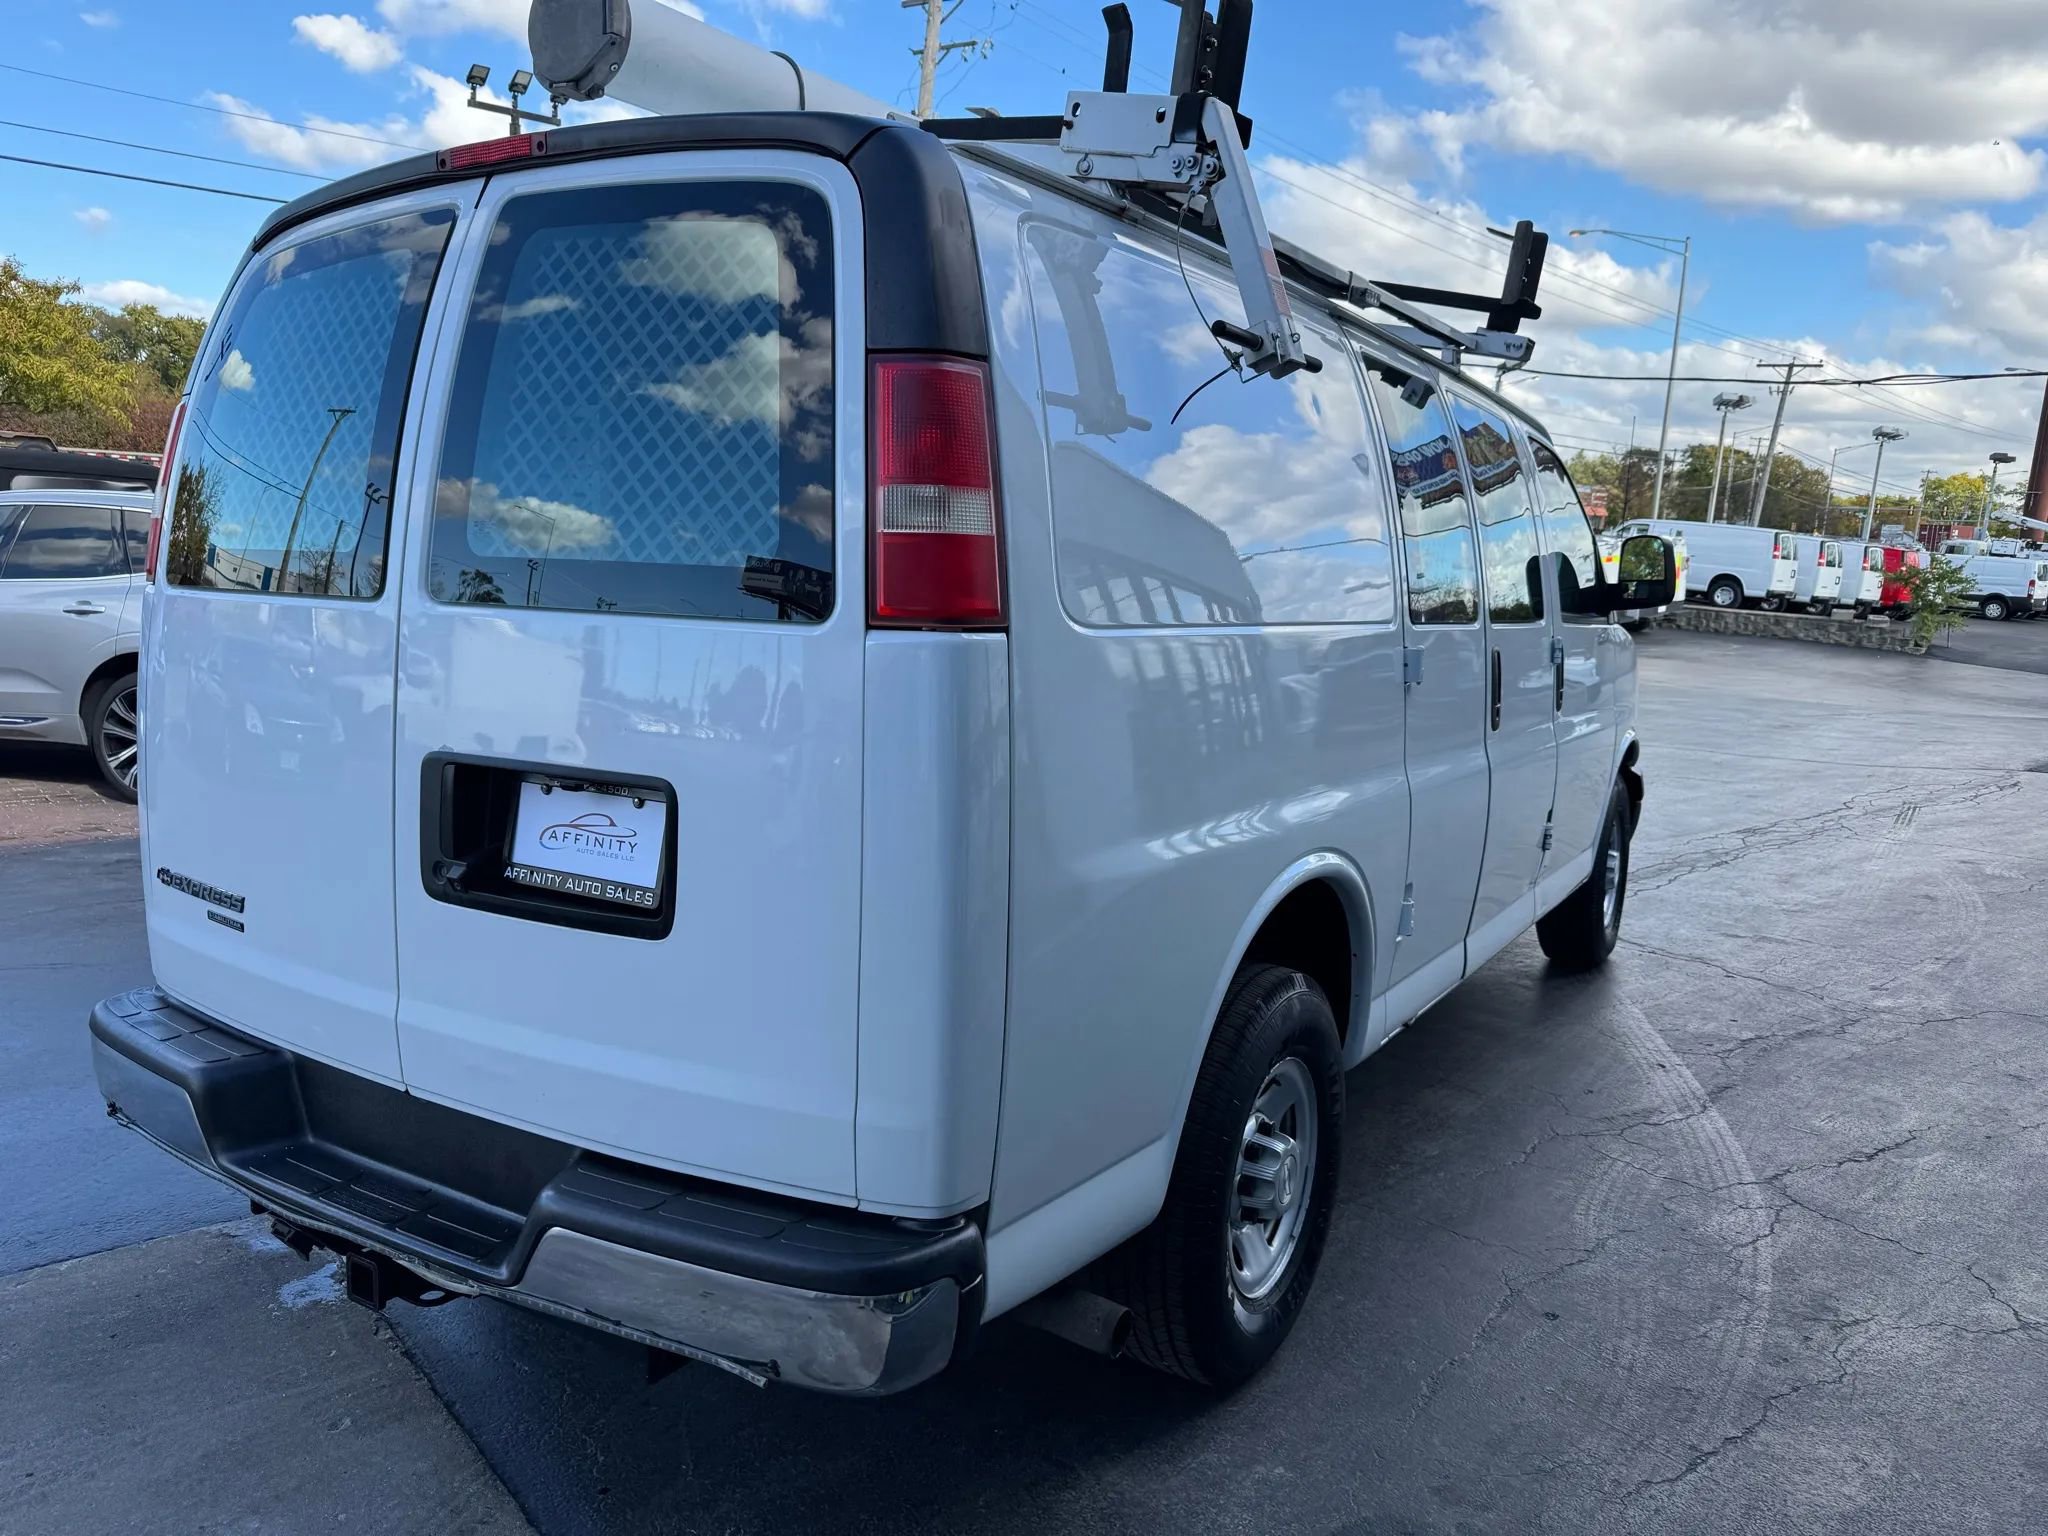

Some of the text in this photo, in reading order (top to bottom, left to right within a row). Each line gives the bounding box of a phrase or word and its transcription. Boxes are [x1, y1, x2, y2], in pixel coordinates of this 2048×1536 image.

[548, 829, 638, 854] AFFINITY
[576, 847, 635, 862] AUTO SALES LLC
[171, 873, 244, 913] EXPRESS
[504, 866, 654, 905] AFFINITY AUTO SALES
